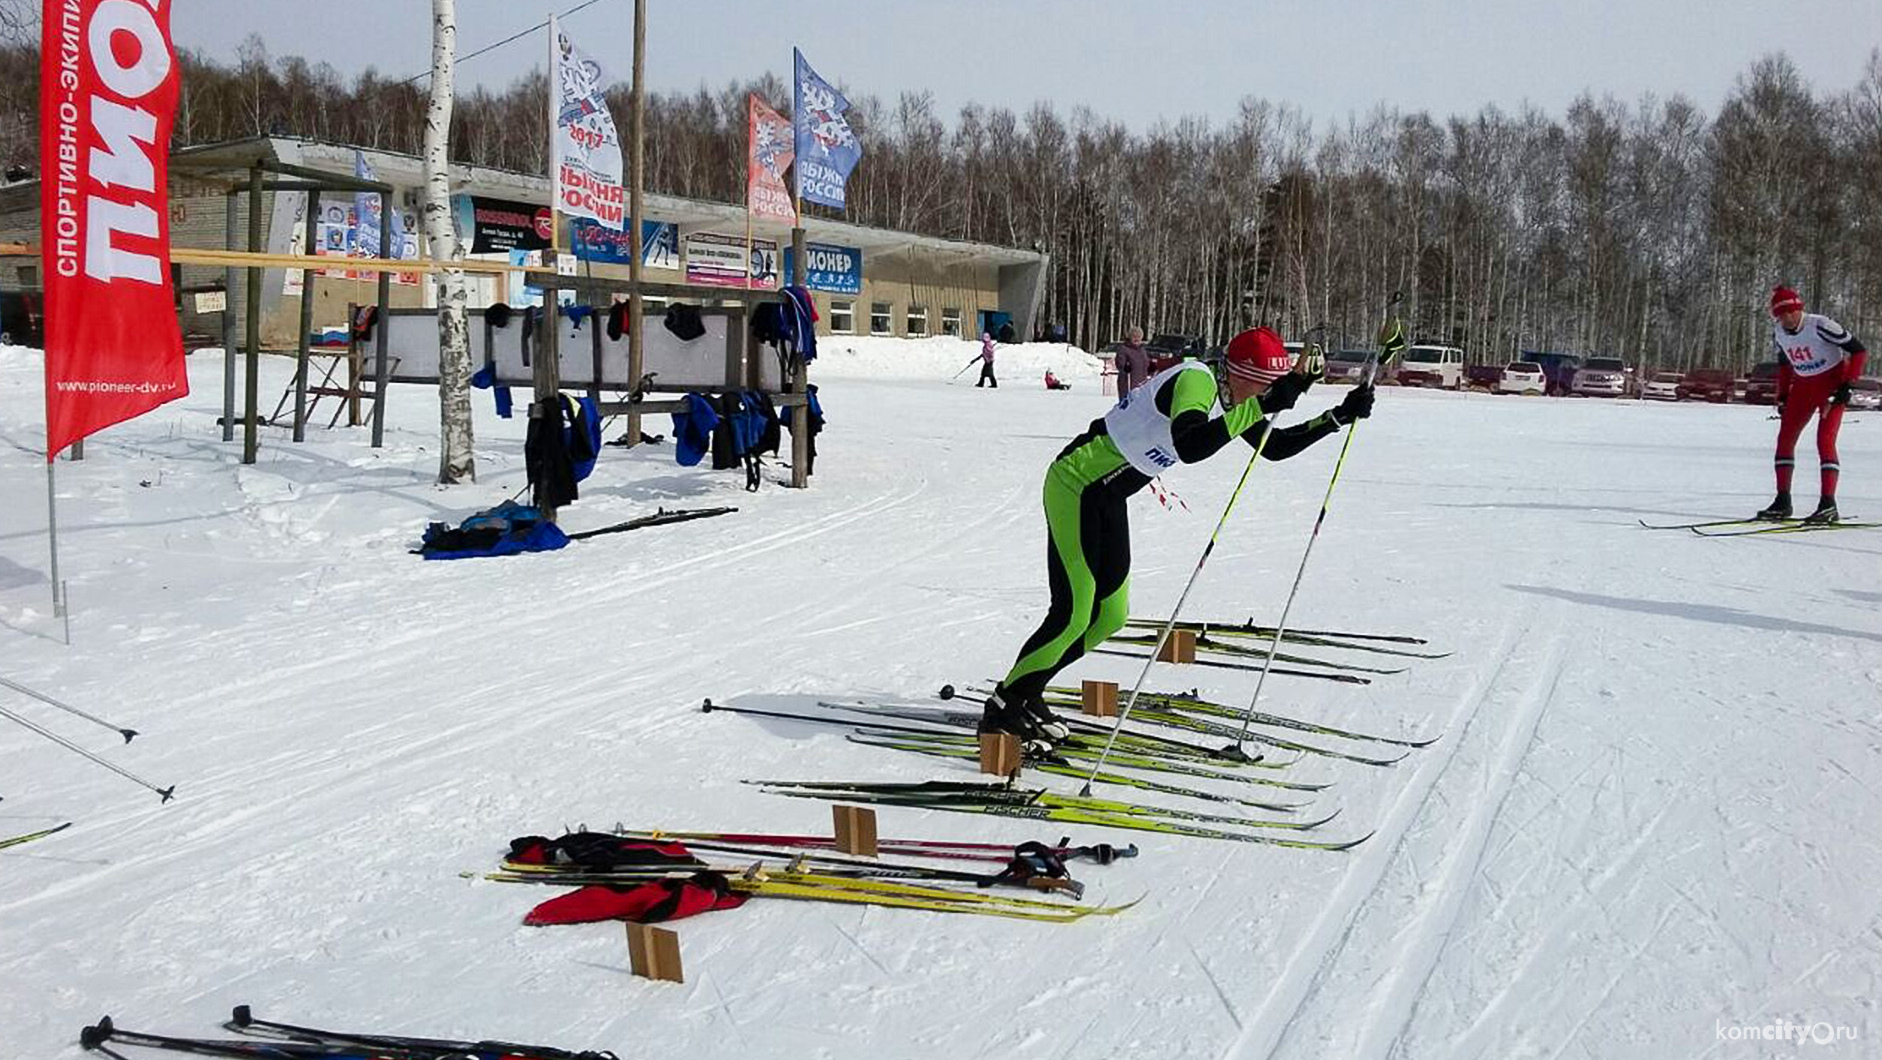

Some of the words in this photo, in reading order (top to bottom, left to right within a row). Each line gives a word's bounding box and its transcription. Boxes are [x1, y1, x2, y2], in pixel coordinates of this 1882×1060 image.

[84, 0, 172, 286] ПИО
[569, 124, 604, 149] 2017
[806, 250, 852, 273] ИОНЕР
[1787, 346, 1813, 362] 141
[56, 381, 177, 394] www.pioneer-dv.ru
[984, 804, 1052, 819] FISCHER
